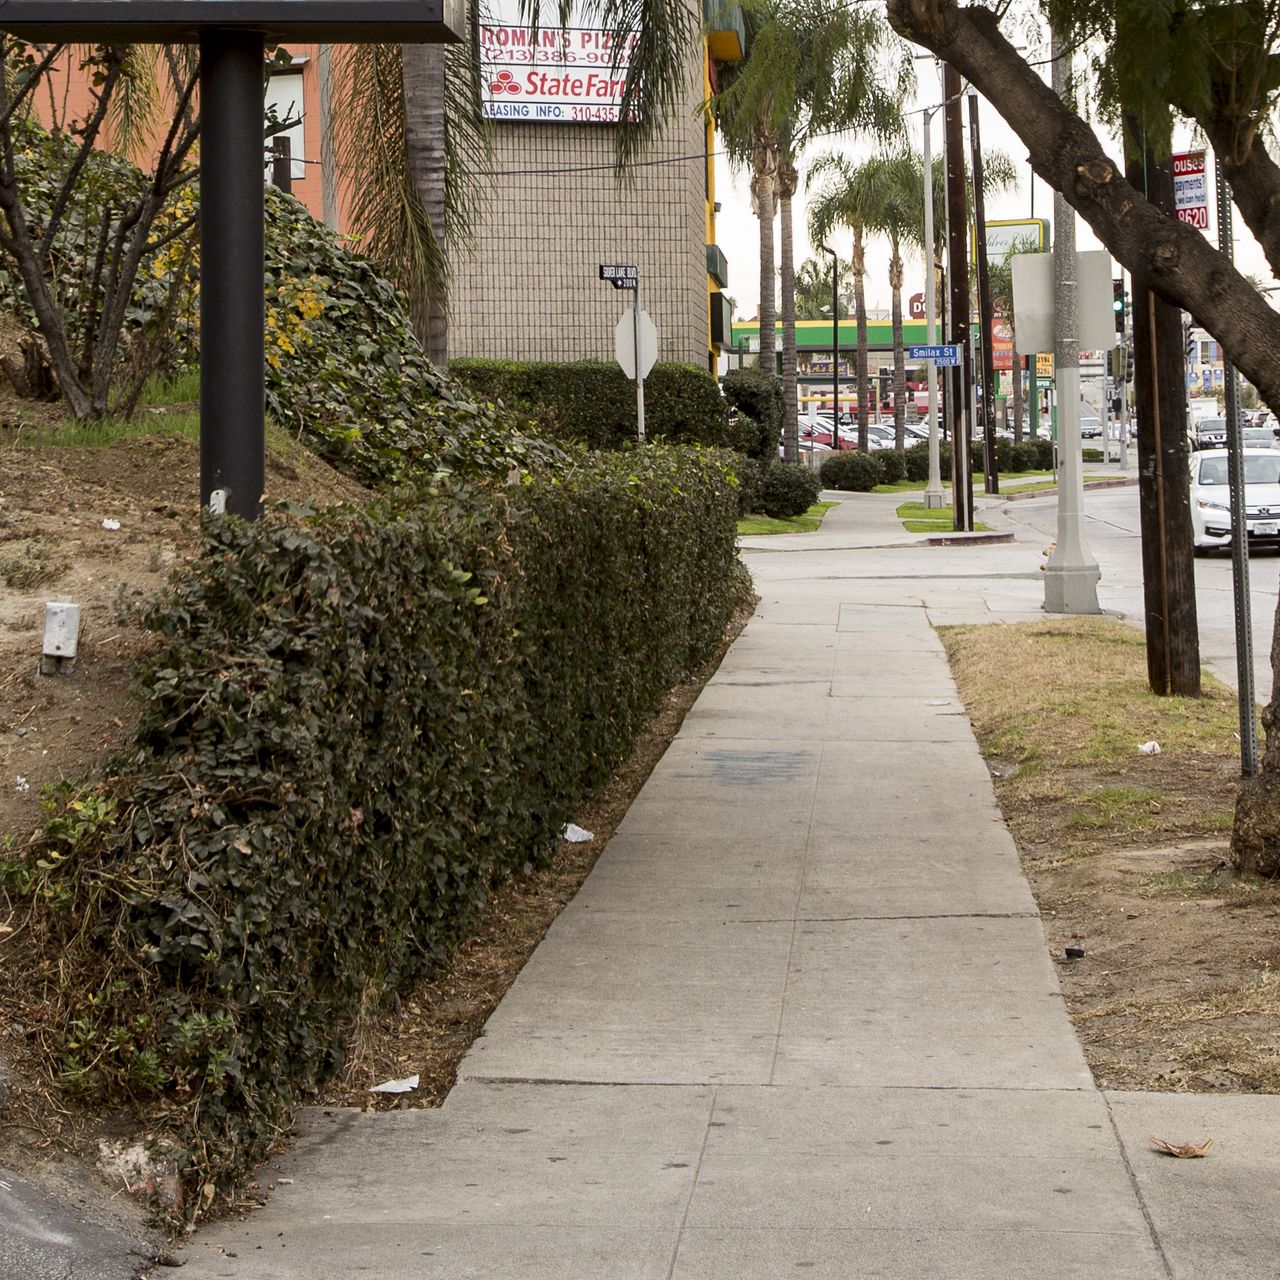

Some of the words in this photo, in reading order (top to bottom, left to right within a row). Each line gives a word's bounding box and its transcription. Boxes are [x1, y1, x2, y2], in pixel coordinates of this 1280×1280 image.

[481, 27, 571, 49] ROMAN'S
[536, 106, 565, 118] INFO:
[1174, 159, 1204, 172] ouses
[913, 348, 940, 358] Smilax
[943, 347, 953, 357] St
